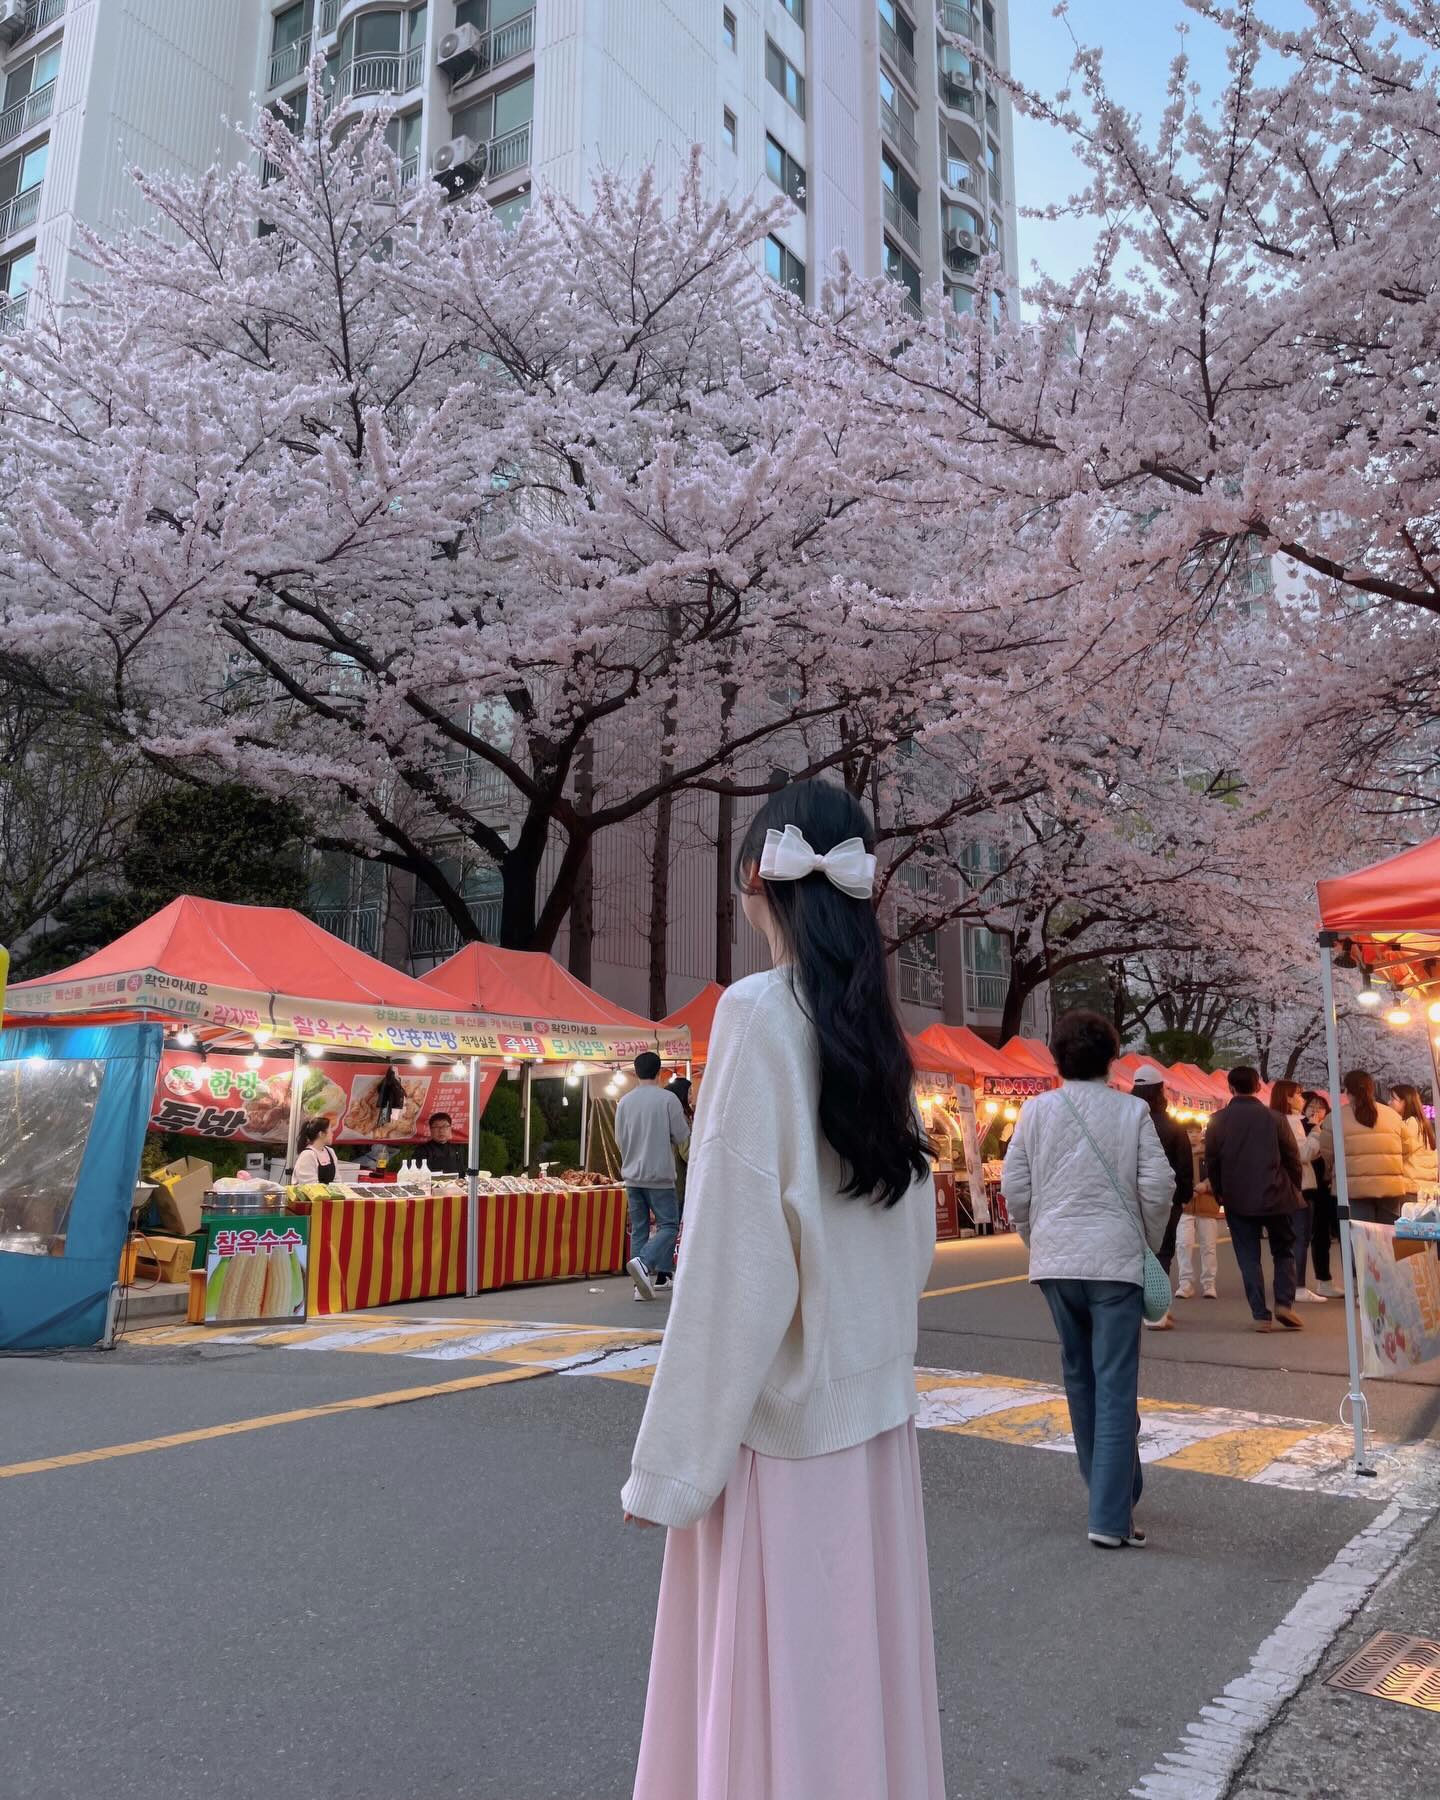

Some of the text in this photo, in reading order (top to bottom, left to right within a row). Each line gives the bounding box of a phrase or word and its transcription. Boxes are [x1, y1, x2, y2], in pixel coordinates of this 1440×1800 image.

[144, 973, 209, 996] 확인하세요
[213, 1004, 261, 1029] 감자떡
[551, 1023, 598, 1035] 확인하세요
[293, 1016, 373, 1043] 찰옥수수
[386, 1027, 457, 1050] 안흥찐빵
[503, 1036, 541, 1055] 족발
[552, 1039, 606, 1057] 모시잎떡
[208, 1069, 260, 1099] 한방
[152, 1099, 248, 1137] 족발
[215, 1228, 302, 1257] 찰옥수수
